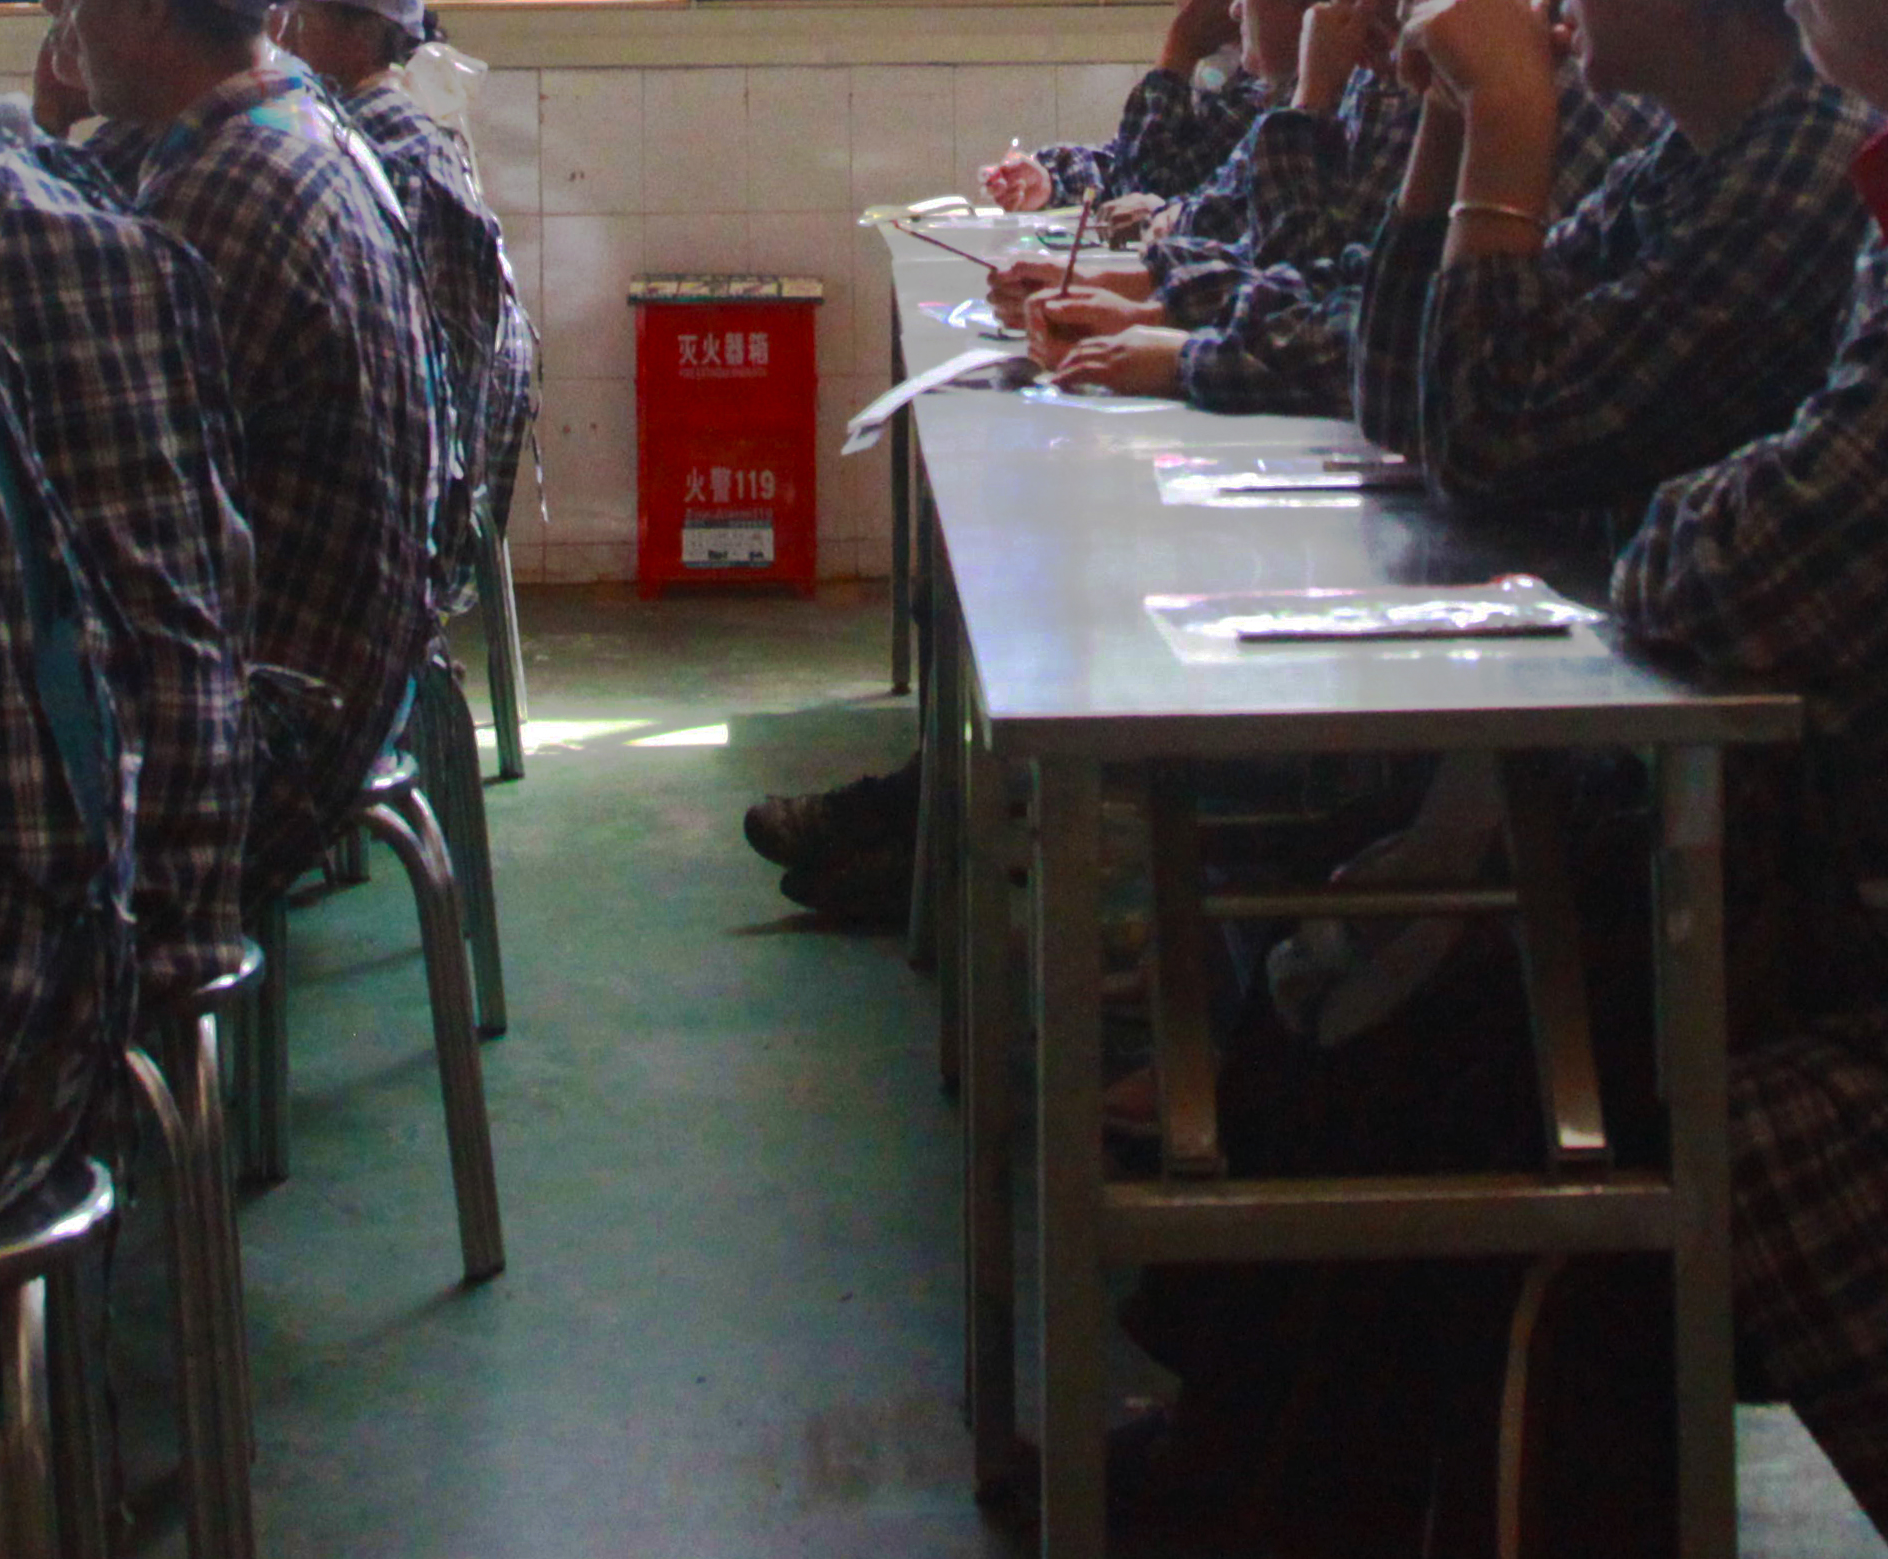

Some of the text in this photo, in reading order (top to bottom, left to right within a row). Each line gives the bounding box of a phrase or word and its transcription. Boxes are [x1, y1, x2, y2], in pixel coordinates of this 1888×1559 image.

[677, 332, 769, 365] 灭火器箱
[684, 466, 776, 503] 火警119
